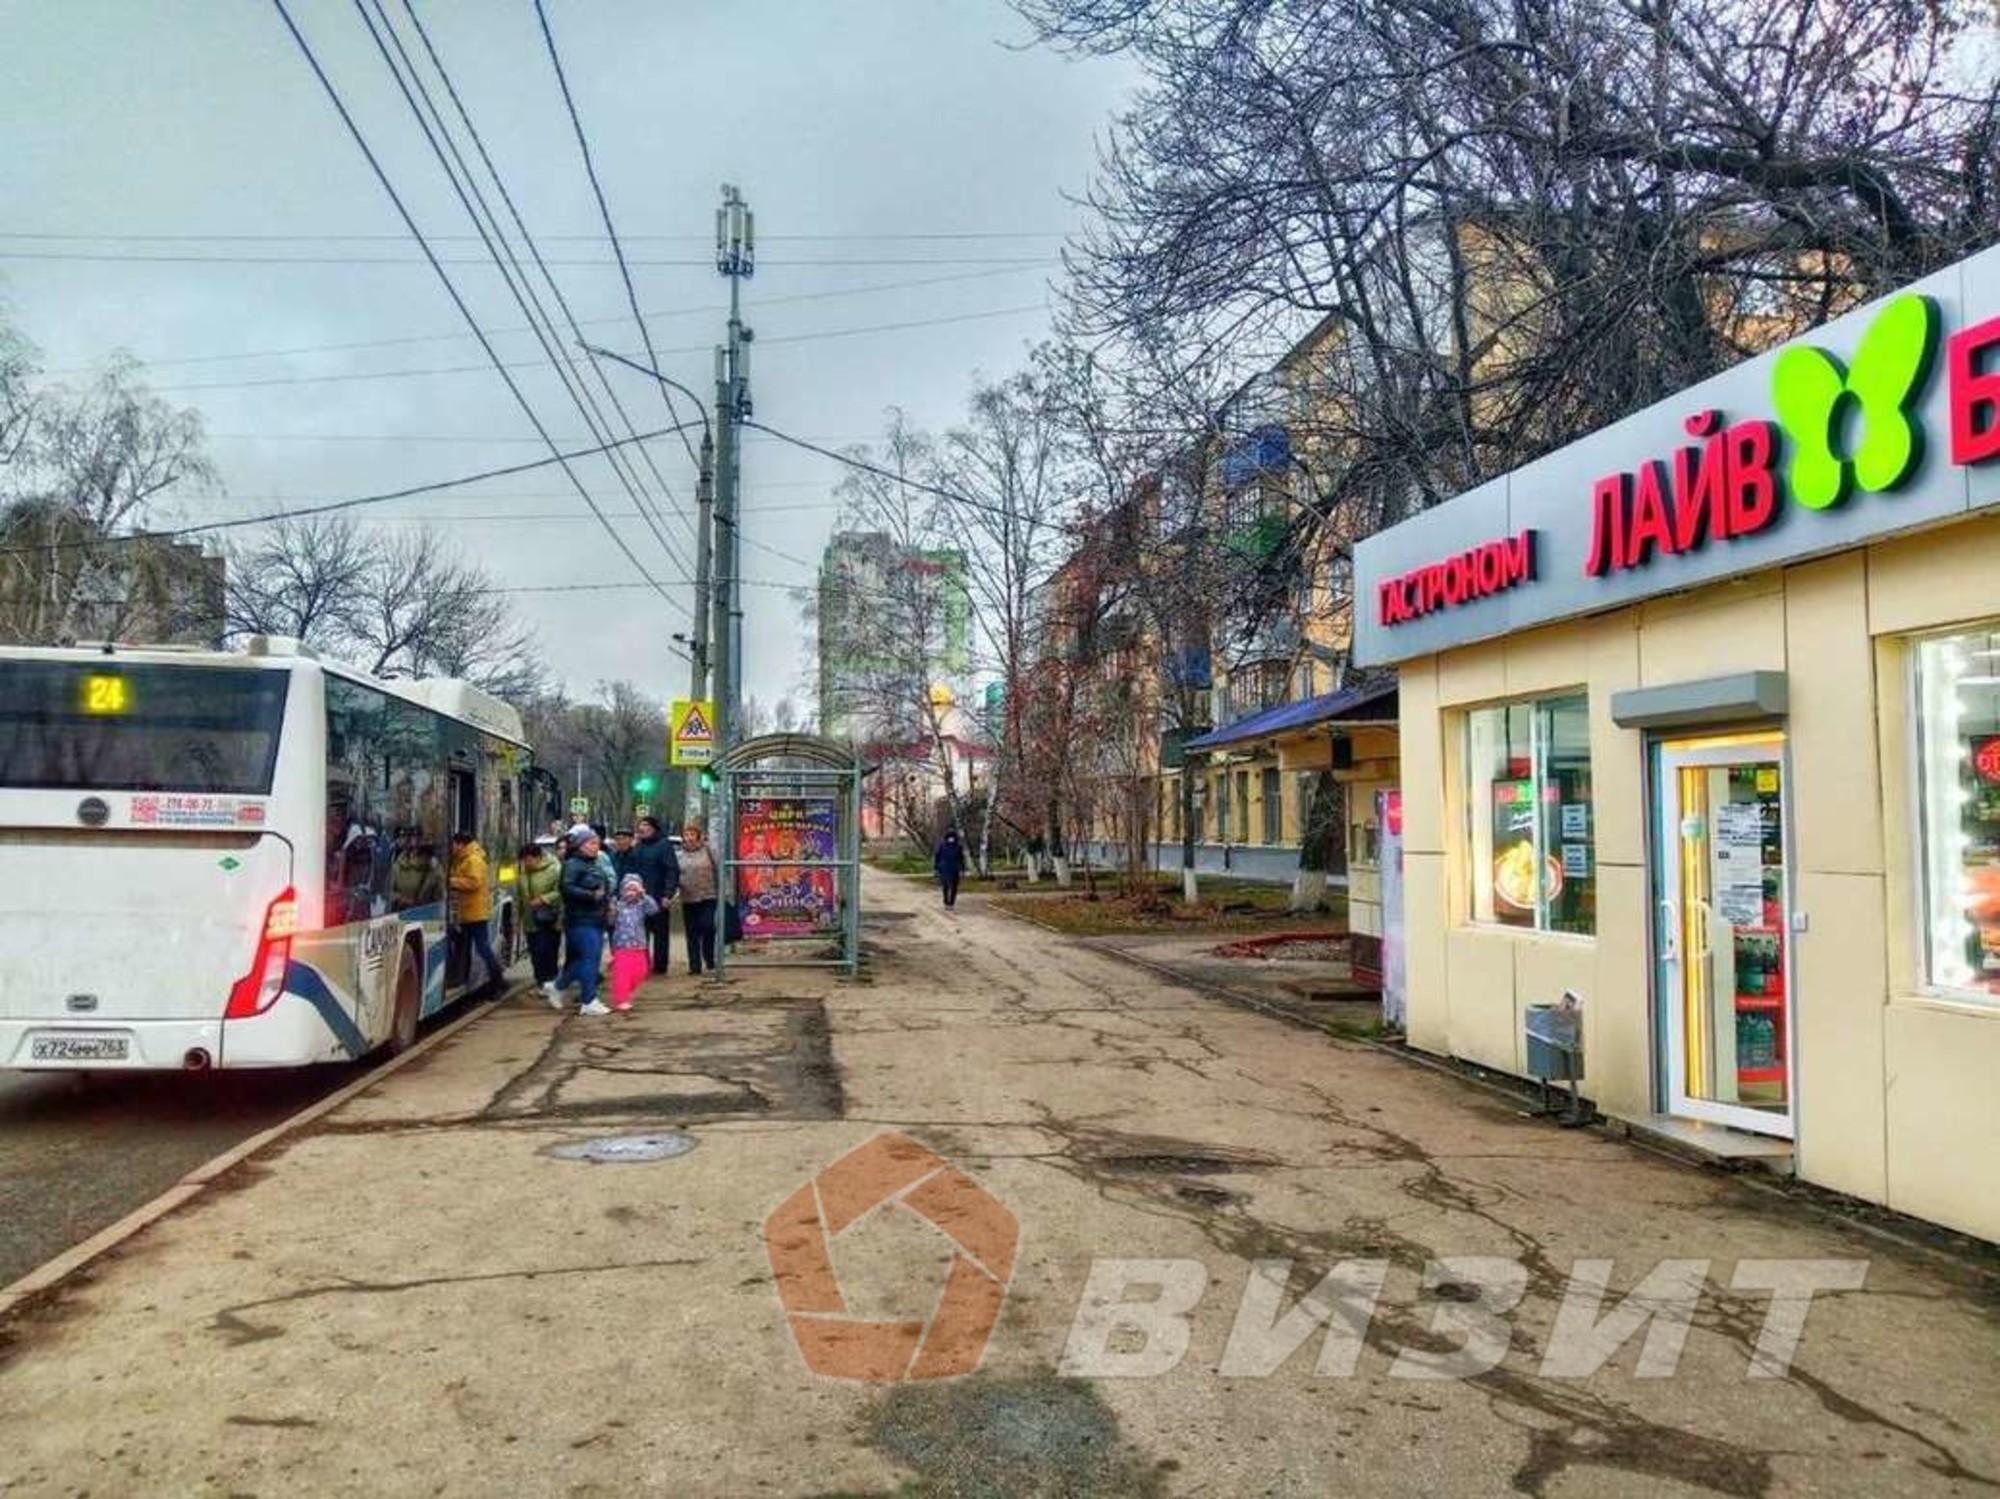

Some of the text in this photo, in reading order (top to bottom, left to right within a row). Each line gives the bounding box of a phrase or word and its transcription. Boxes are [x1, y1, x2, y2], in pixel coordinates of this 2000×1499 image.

[1376, 528, 1537, 627] ГАСТРОНОМ
[1584, 408, 1784, 577] ЛАЙВ
[88, 676, 124, 711] 24
